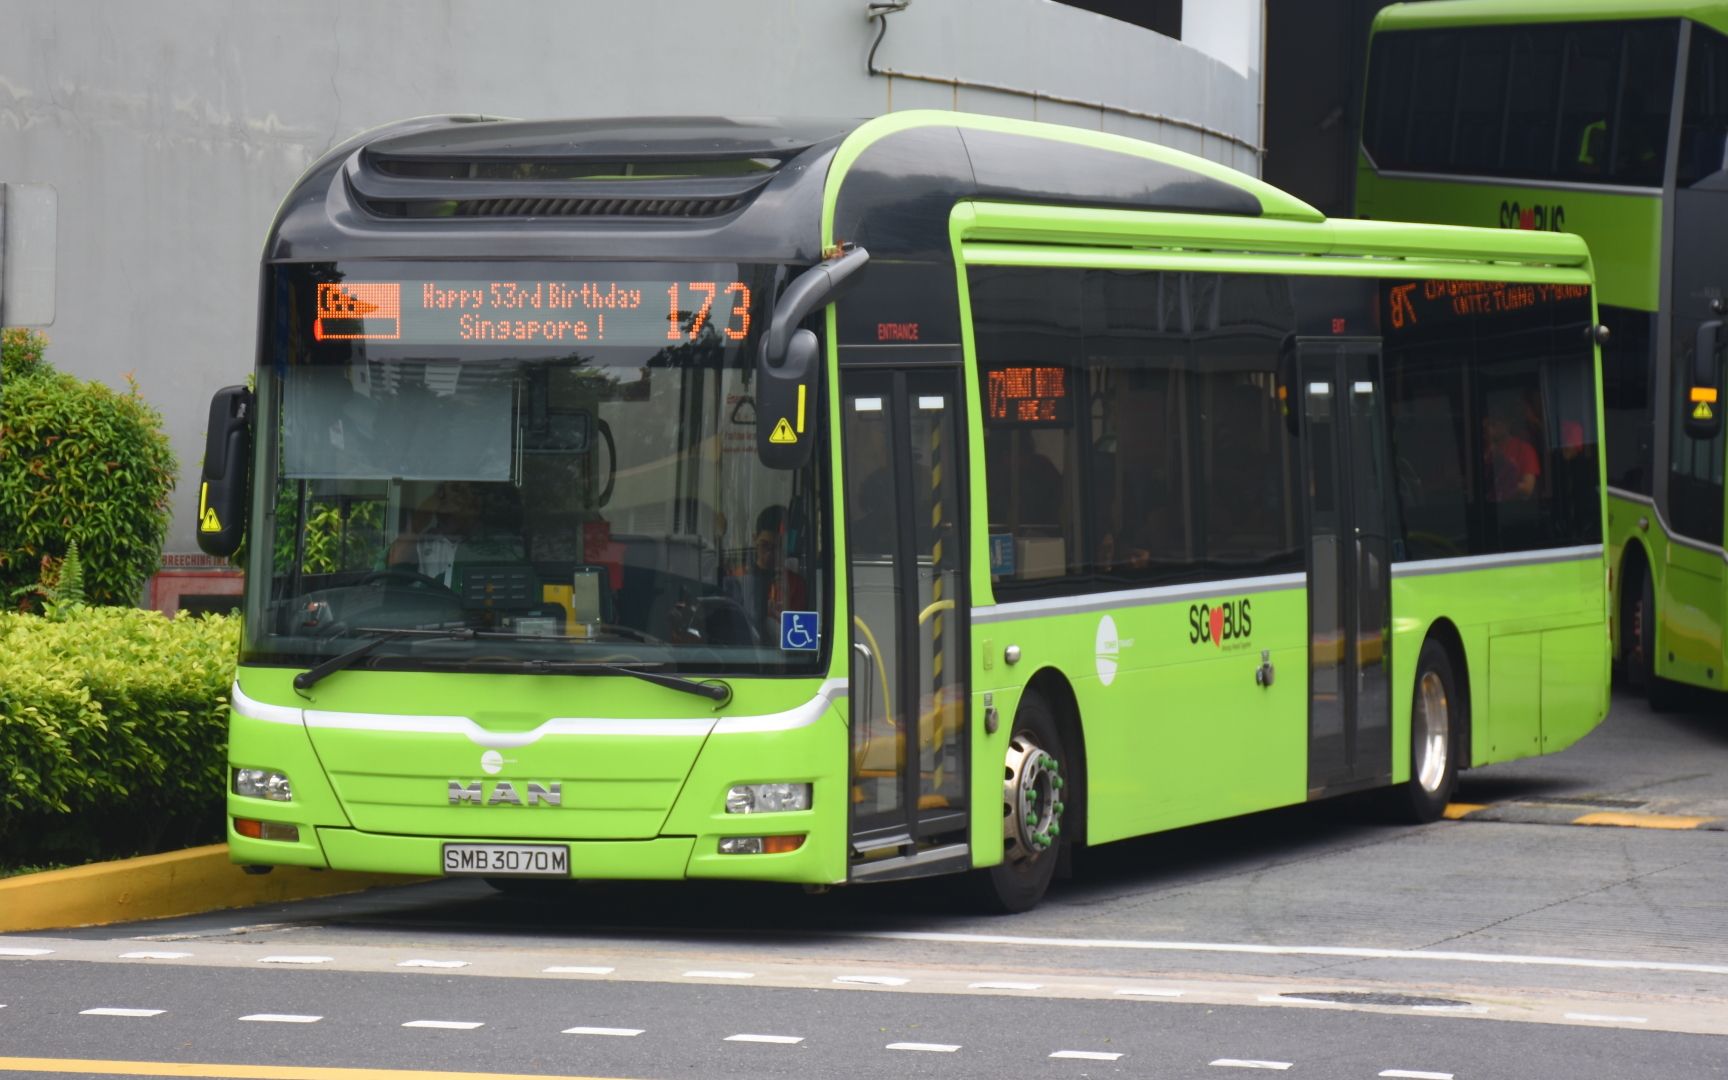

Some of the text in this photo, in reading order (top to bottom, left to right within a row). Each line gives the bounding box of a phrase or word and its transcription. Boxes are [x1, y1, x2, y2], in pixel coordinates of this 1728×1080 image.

[423, 282, 641, 309] Happy 53rd Birthday
[667, 282, 752, 340] 173
[459, 313, 588, 340] Singapore
[878, 323, 919, 340] ENTRANCE
[448, 780, 562, 806] MAN
[446, 849, 566, 871] SMB3070M
